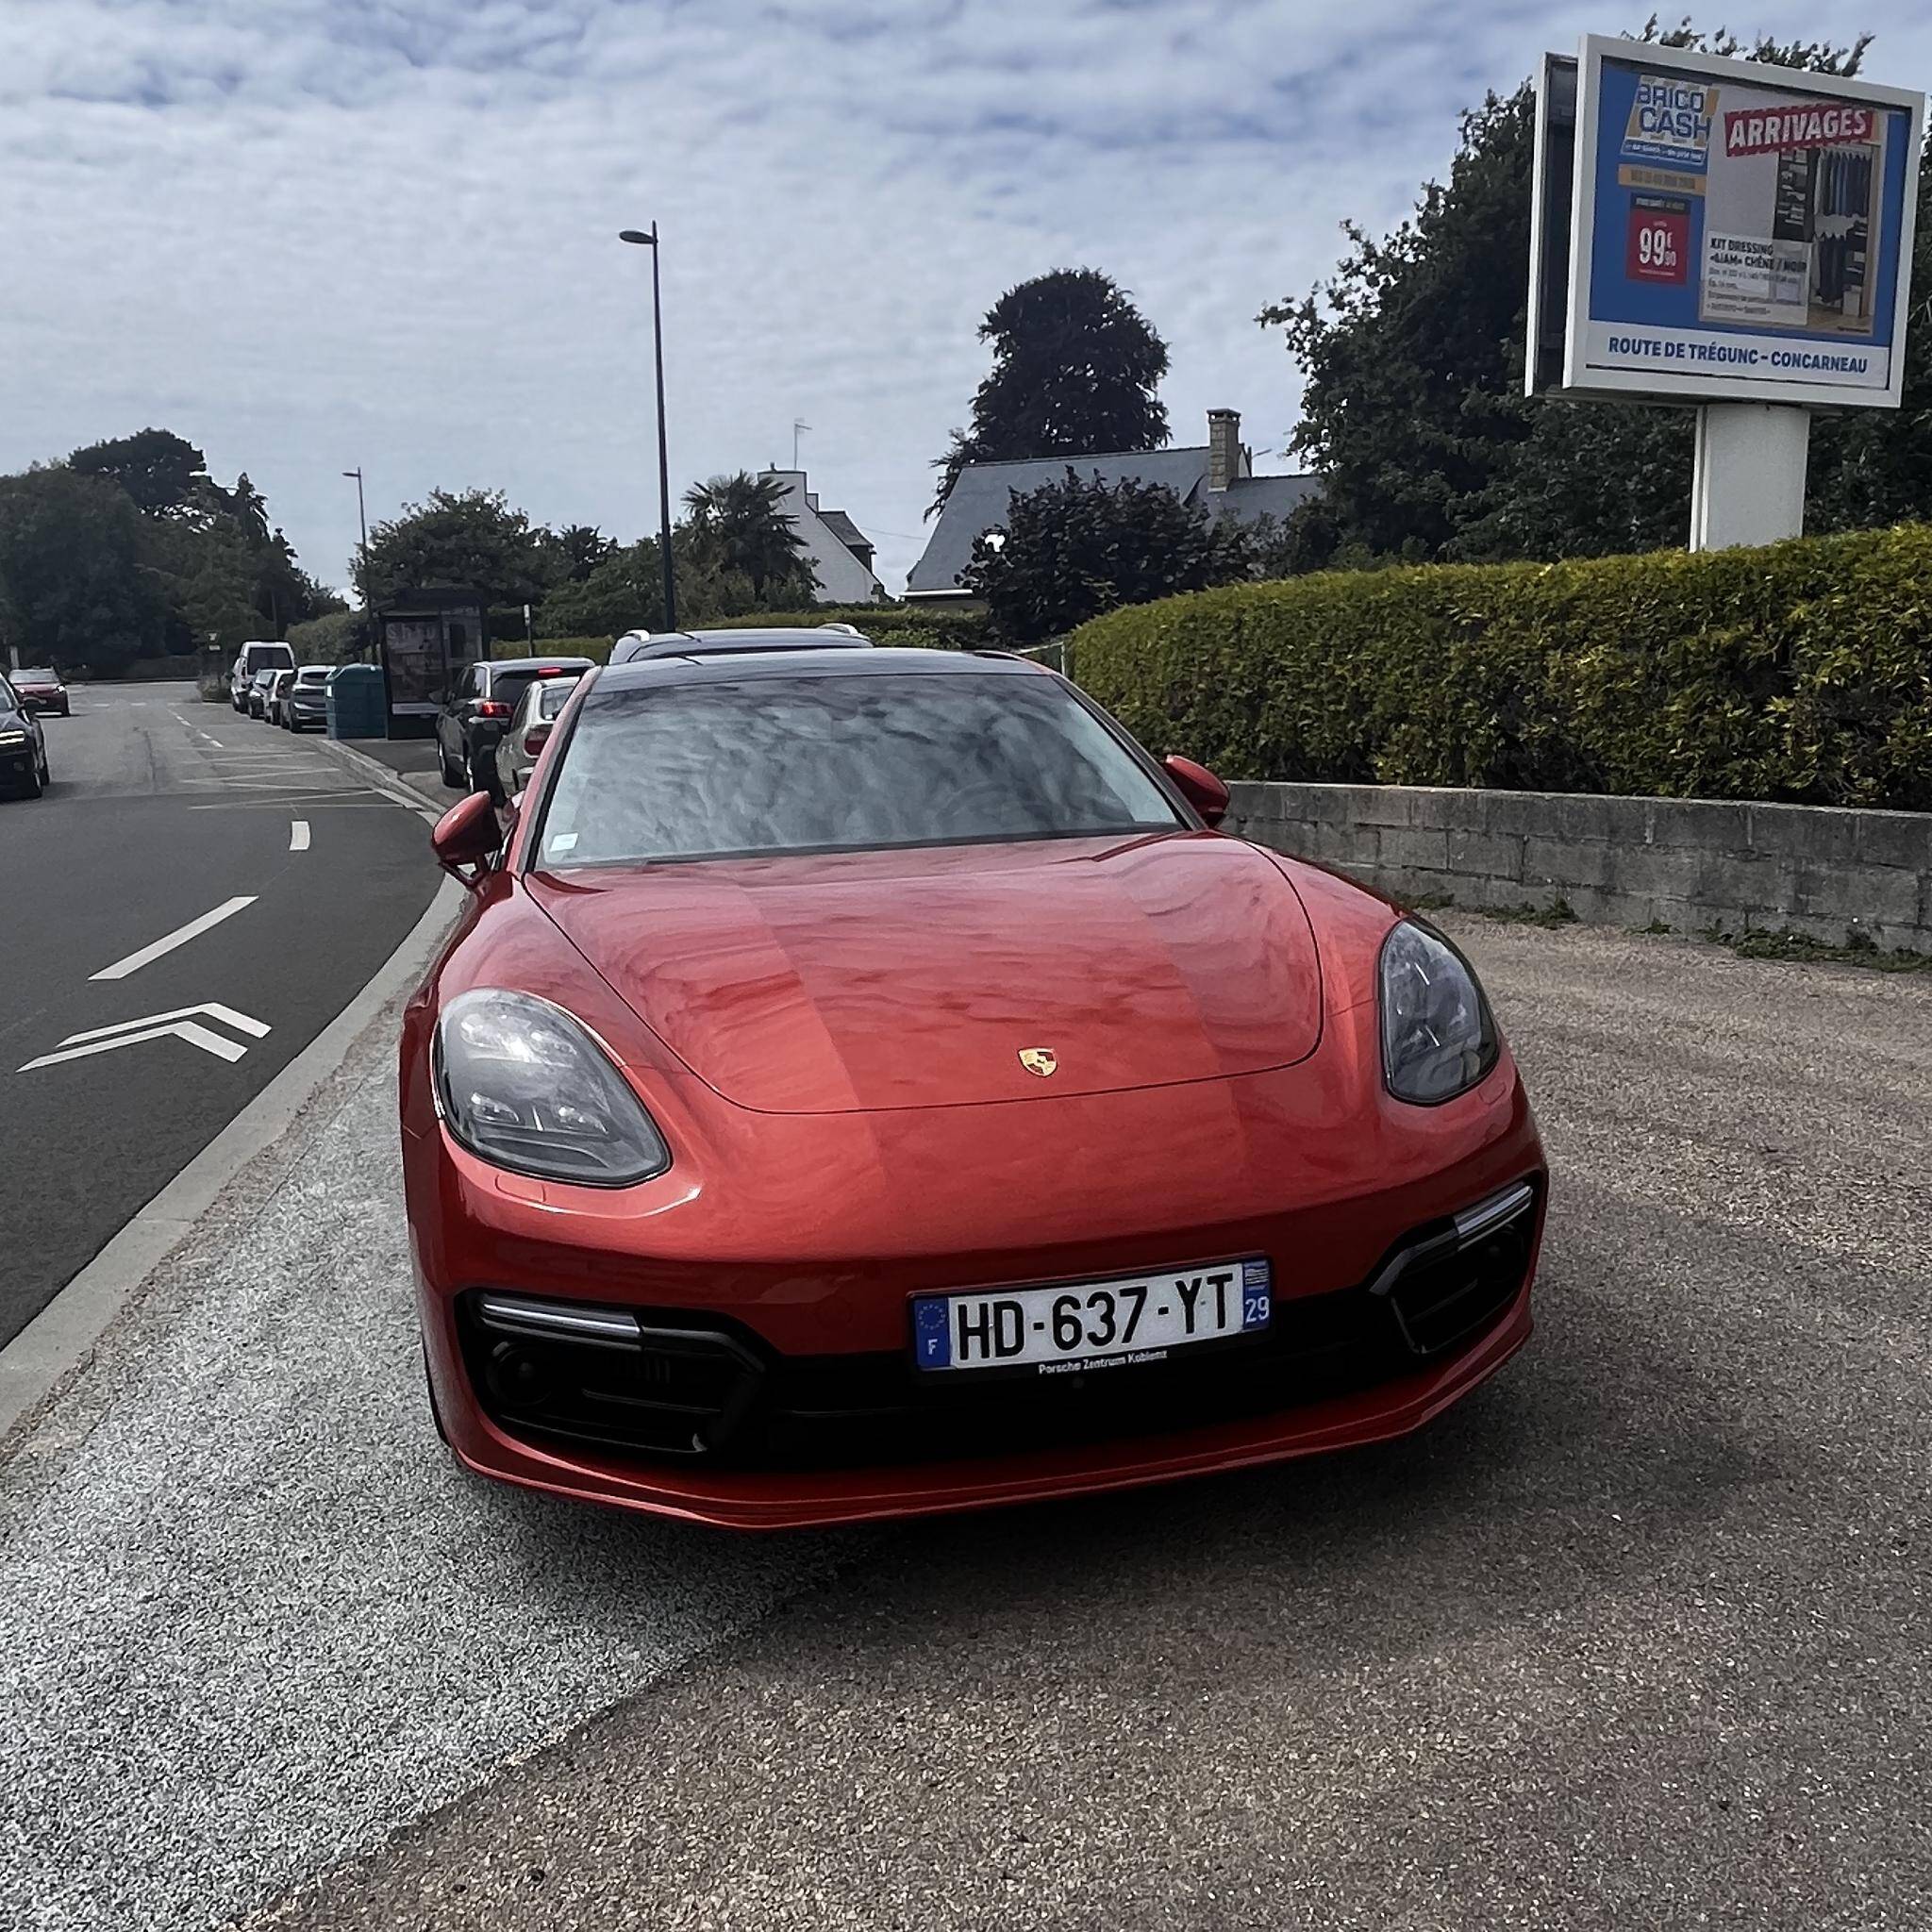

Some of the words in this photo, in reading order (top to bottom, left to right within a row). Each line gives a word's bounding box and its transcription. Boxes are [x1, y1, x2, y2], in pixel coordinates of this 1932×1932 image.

[1637, 84, 1705, 113] BRICO
[1640, 107, 1711, 142] CASH
[1728, 108, 1866, 149] ARRIVAGES
[1728, 240, 1774, 256] DRESSING
[1608, 337, 1661, 357] ROUTE
[1664, 341, 1685, 358] DE
[1689, 341, 1758, 365] TRÉGUNC
[1771, 351, 1868, 375] CONCARNEAU
[1245, 1296, 1270, 1323] 29
[927, 1338, 938, 1356] F
[1039, 1361, 1081, 1374] Porsche
[1083, 1357, 1126, 1370] Zentrum
[1127, 1350, 1168, 1364] Koblenz
